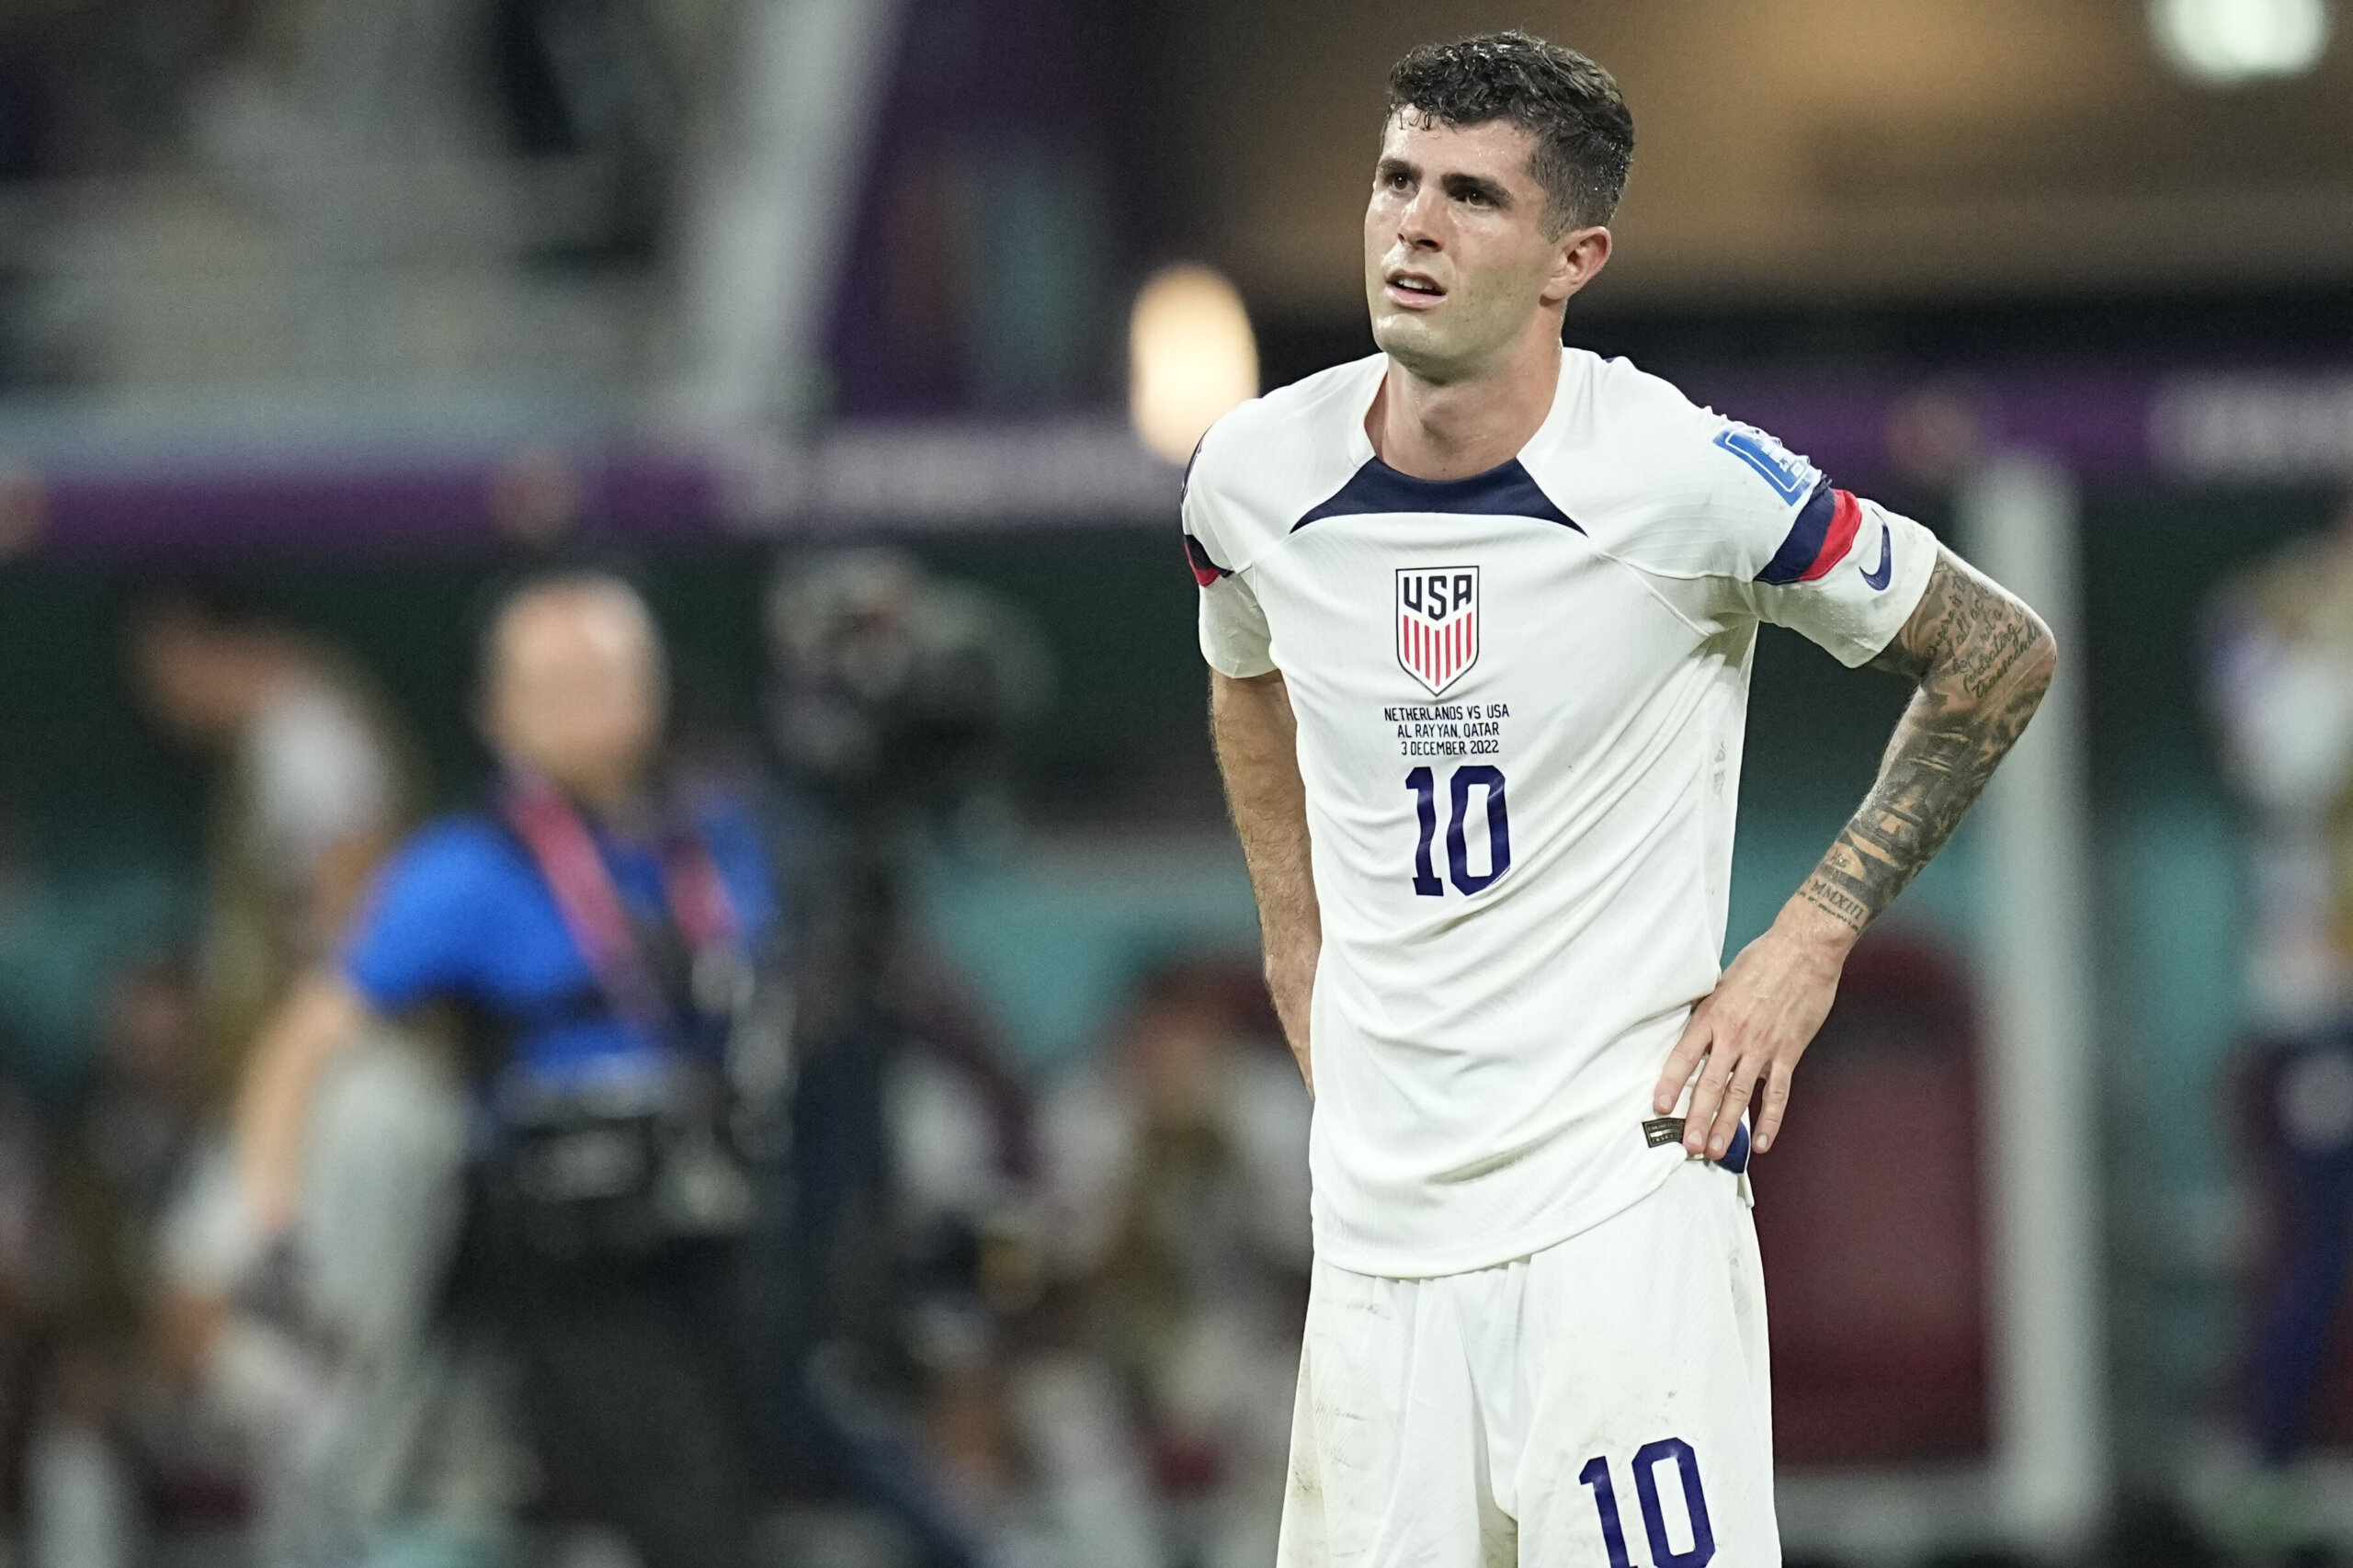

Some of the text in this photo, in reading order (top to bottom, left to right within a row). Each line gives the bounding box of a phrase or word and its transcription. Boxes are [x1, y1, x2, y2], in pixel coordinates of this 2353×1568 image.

[1404, 574, 1472, 621] USA
[1384, 704, 1510, 722] NETHERLANDS VS USA
[1397, 722, 1500, 739] AL RAYYAN, QATAR
[1401, 740, 1499, 756] 3 DECEMBER 2022
[1405, 765, 1511, 897] 10
[1578, 1437, 1716, 1568] 10
